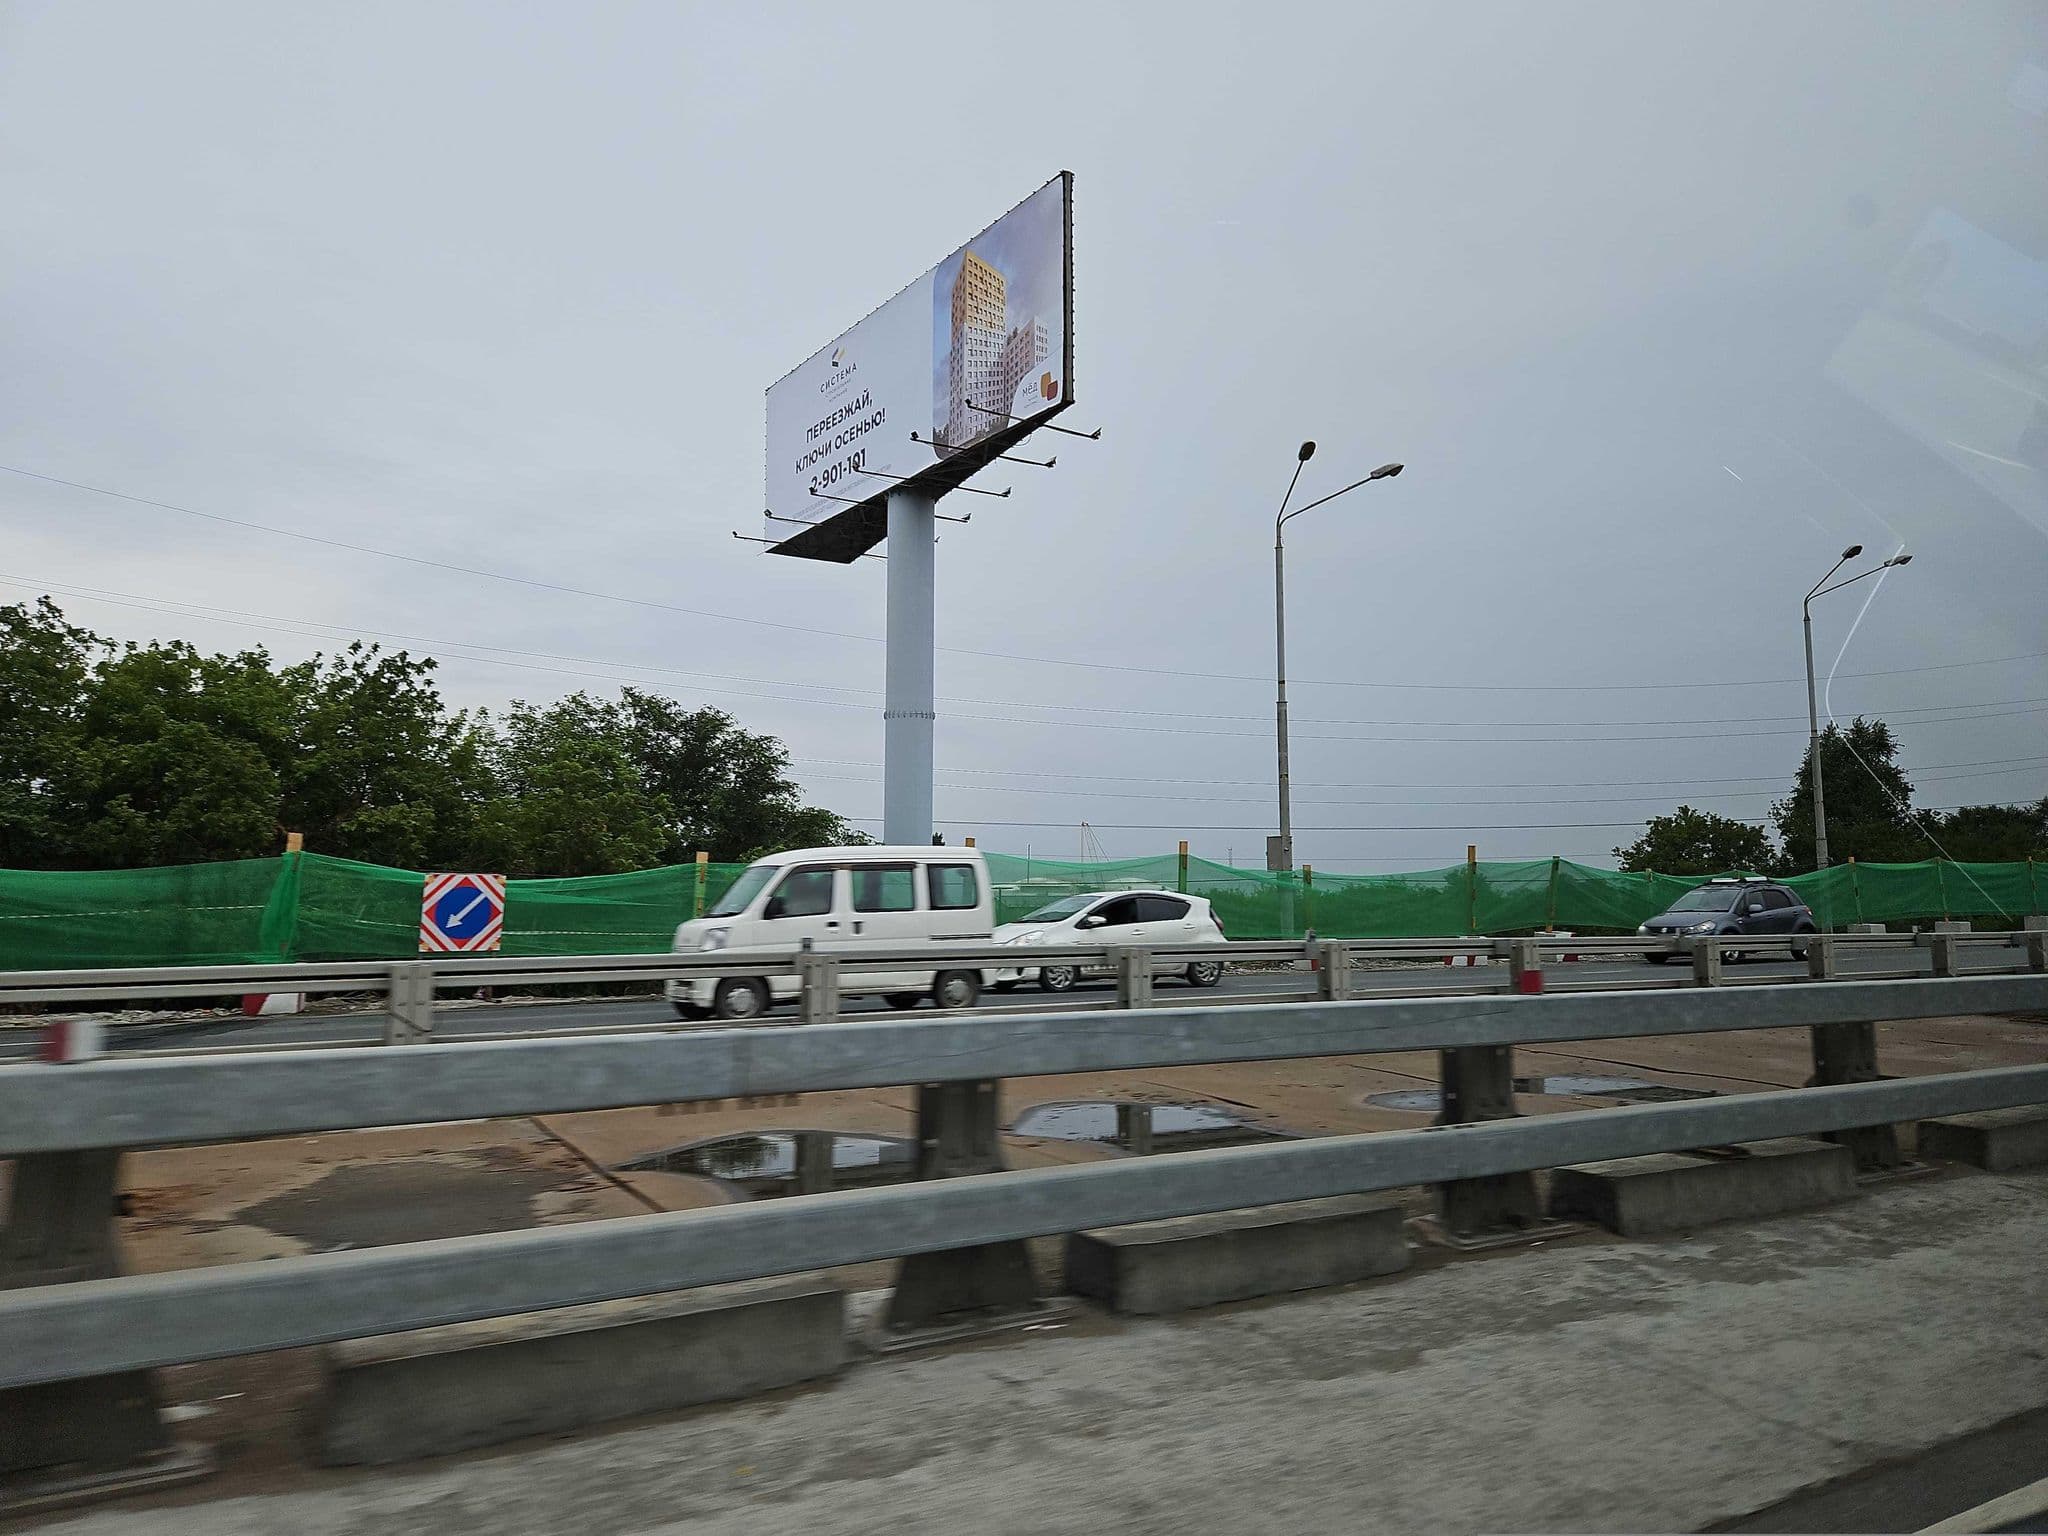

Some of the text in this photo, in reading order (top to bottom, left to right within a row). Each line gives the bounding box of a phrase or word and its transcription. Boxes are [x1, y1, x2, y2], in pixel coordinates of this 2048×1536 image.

[820, 362, 857, 393] СИСТЕМА
[806, 388, 873, 443] ПЕРЕЕЗЖАЙ,
[795, 408, 886, 474] КЛЮЧИ ОСЕНЬЮ!
[810, 448, 866, 492] 2-901-101
